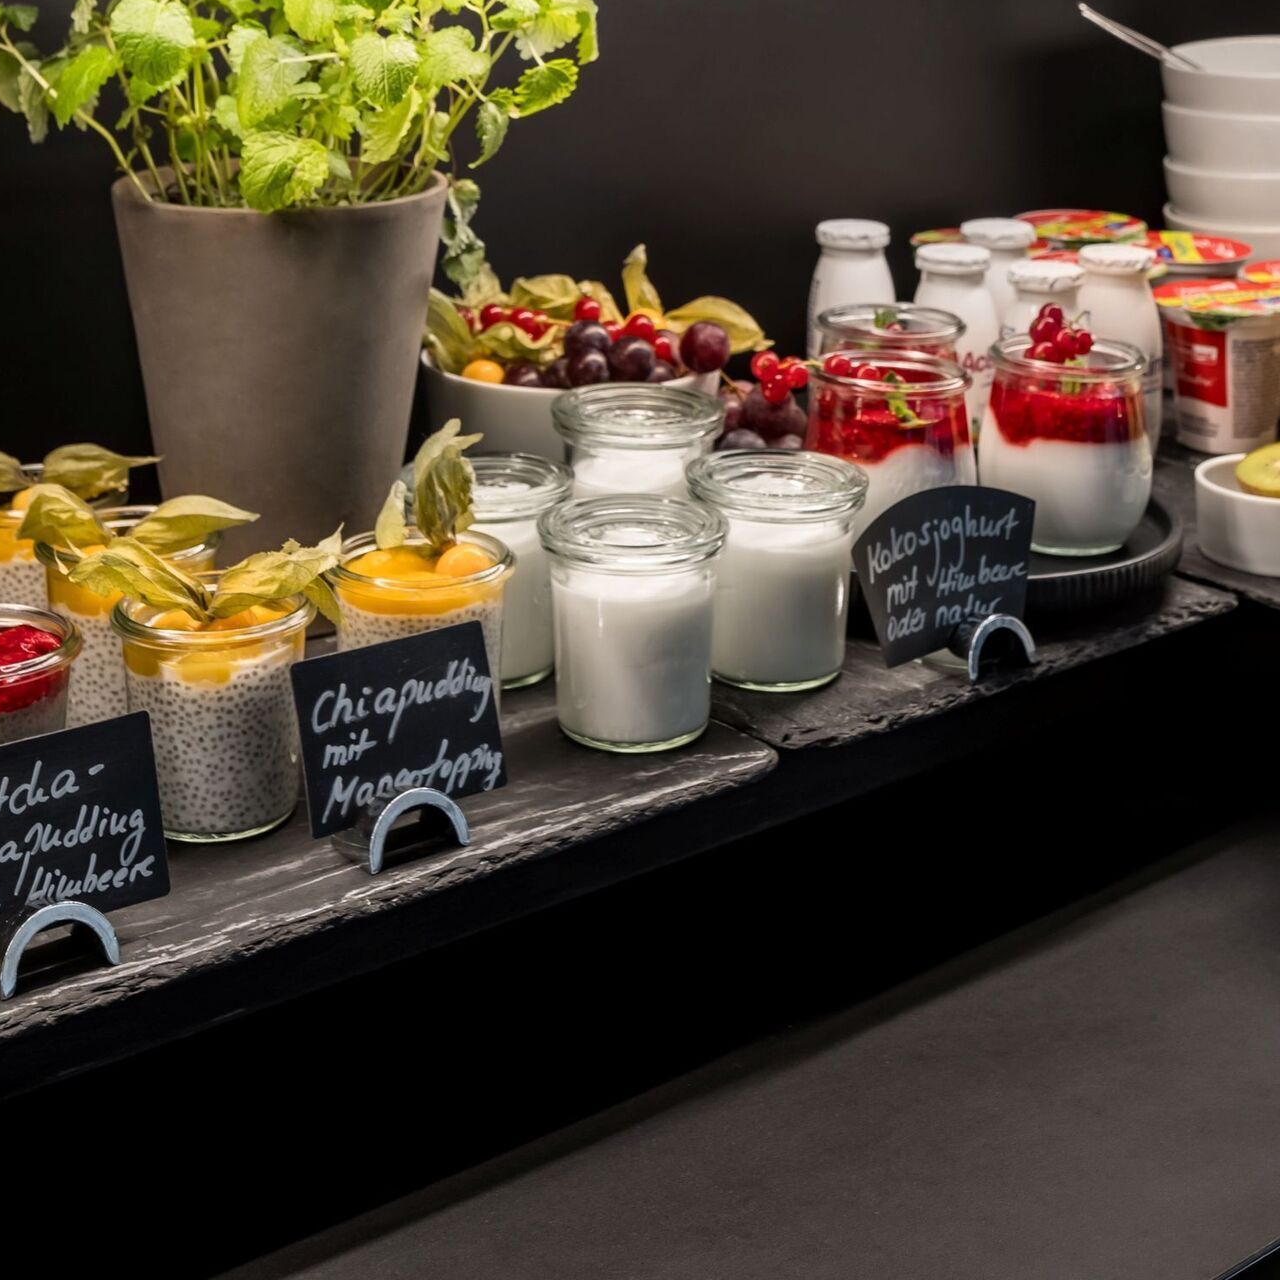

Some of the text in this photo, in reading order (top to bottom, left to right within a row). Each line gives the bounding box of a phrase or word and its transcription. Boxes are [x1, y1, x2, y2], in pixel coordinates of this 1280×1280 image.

[867, 504, 1019, 587] Kokosjoghurt
[887, 565, 918, 613] mit
[887, 594, 1003, 642] oder natur
[312, 657, 493, 745] Chiapudding
[322, 728, 377, 769] mit
